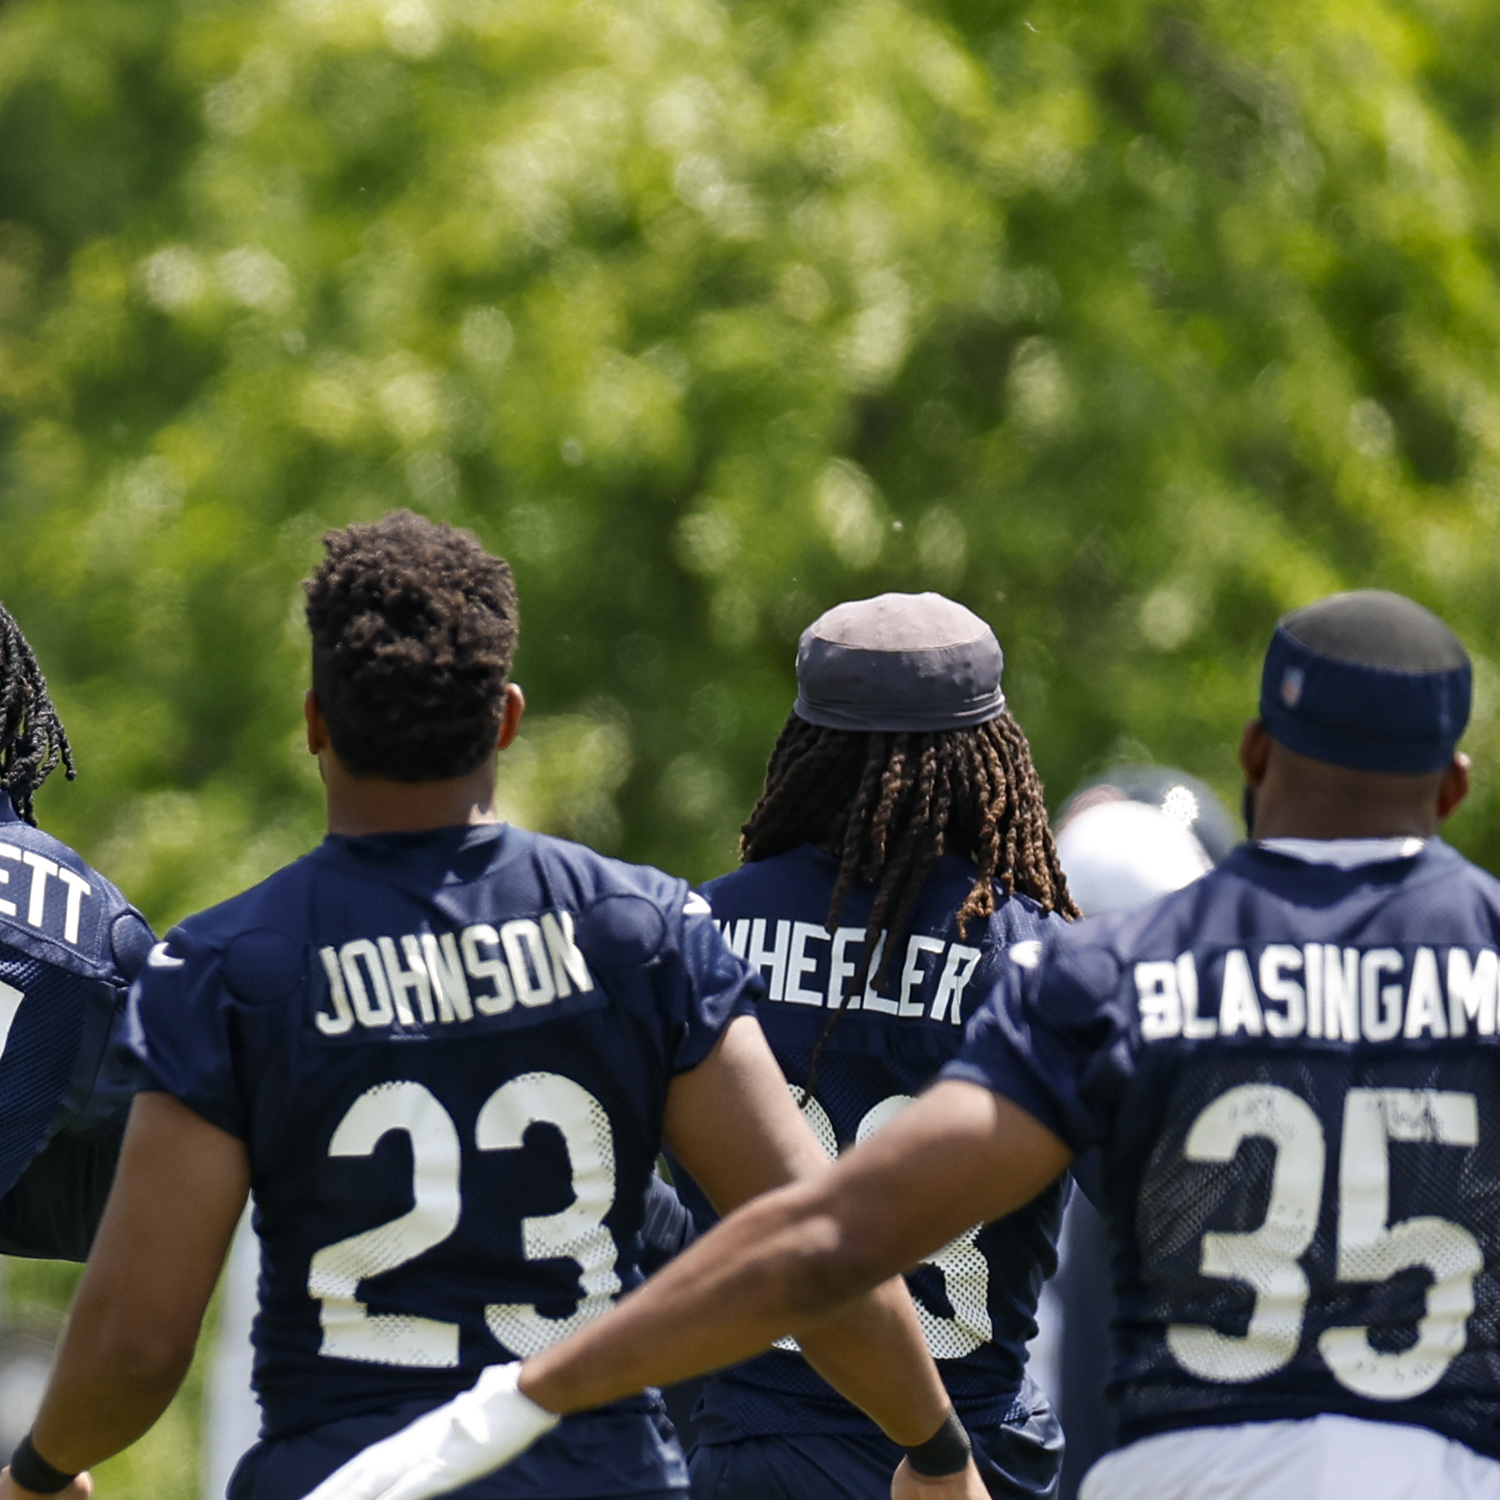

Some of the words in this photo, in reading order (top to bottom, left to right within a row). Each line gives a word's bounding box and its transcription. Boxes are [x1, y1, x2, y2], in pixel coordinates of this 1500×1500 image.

[315, 910, 595, 1036] JOHNSON
[1134, 942, 1500, 1043] BLASINGAM
[307, 1071, 622, 1368] 23
[1166, 1082, 1486, 1402] 35
